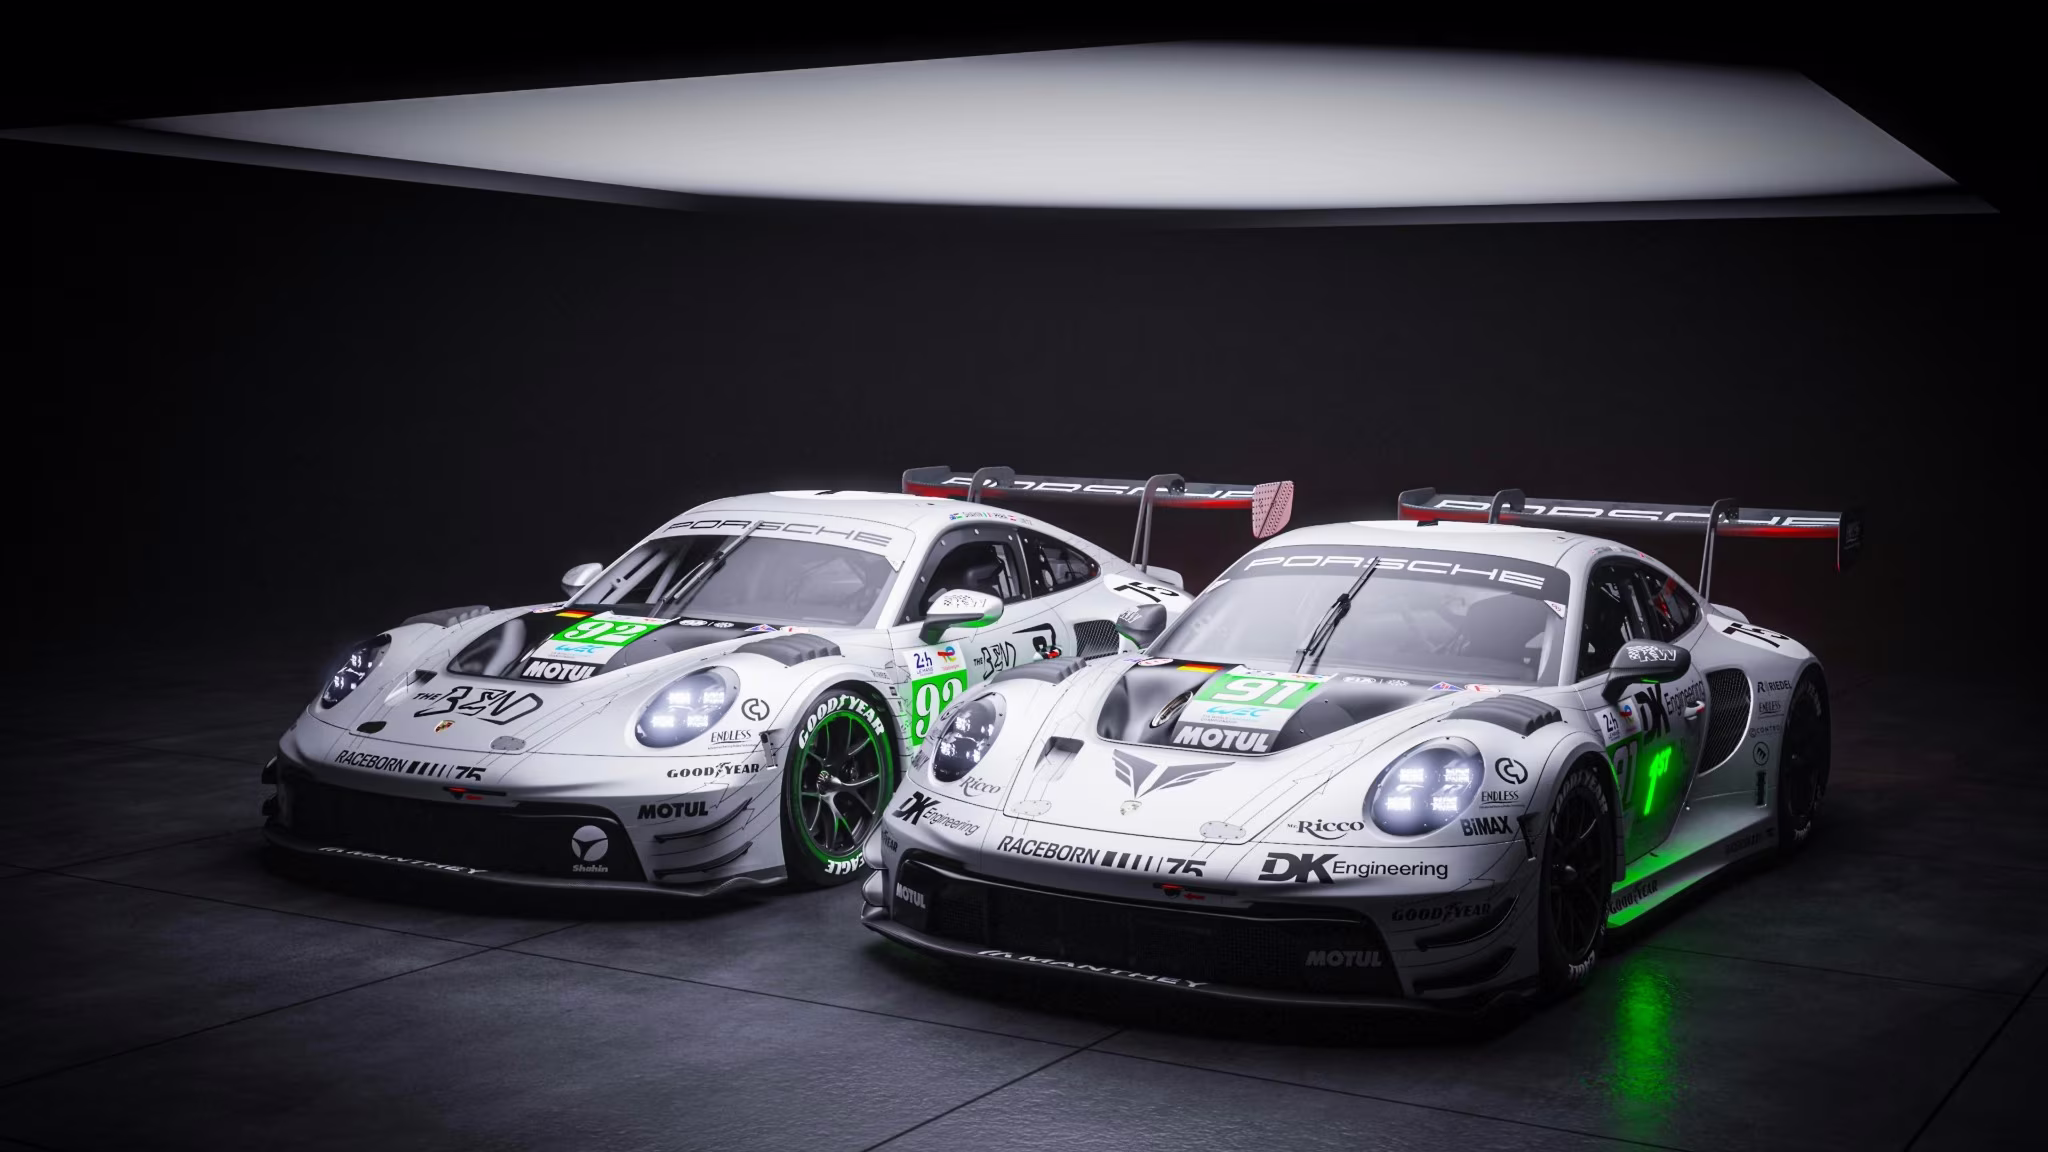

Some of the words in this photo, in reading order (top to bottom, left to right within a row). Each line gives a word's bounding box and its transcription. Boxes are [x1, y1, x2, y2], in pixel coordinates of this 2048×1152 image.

[663, 520, 892, 547] PORSCHE
[1244, 555, 1545, 589] PORSCHE
[564, 621, 648, 643] 92
[974, 658, 984, 666] THE
[1638, 648, 1677, 662] KW
[522, 660, 596, 682] MOTUL
[412, 692, 443, 701] THE
[1211, 678, 1305, 705] 91
[1768, 680, 1793, 691] RIEDEL
[413, 686, 543, 725] BEND
[1634, 683, 1671, 745] DK
[1664, 680, 1706, 717] Engineering
[798, 693, 885, 750] GOODYEAR
[710, 729, 752, 743] ENDLESS
[1173, 725, 1270, 752] MOTUL
[334, 749, 409, 773] RACEBORN
[455, 765, 487, 781] 75
[666, 762, 760, 778] GOODYEAR
[959, 776, 1002, 798] Ricco
[1481, 790, 1520, 802] ENDLESS
[636, 801, 709, 820] MOTUL
[892, 791, 941, 826] DK
[922, 807, 981, 836] Engineering
[1297, 819, 1365, 840] Ricco
[1460, 815, 1514, 837] BiMAX
[347, 851, 488, 874] MANTHEY
[824, 851, 865, 875] EAGLE
[997, 836, 1100, 865] RACEBORN
[1165, 857, 1207, 877] 75
[572, 864, 609, 873] Shahin
[1258, 852, 1339, 884] DK
[1332, 861, 1448, 879] Engineering
[895, 882, 926, 909] MOTUL
[1390, 902, 1492, 922] GOODYEAR
[1304, 950, 1382, 968] MOTUL
[1018, 955, 1208, 988] MANTHEY
